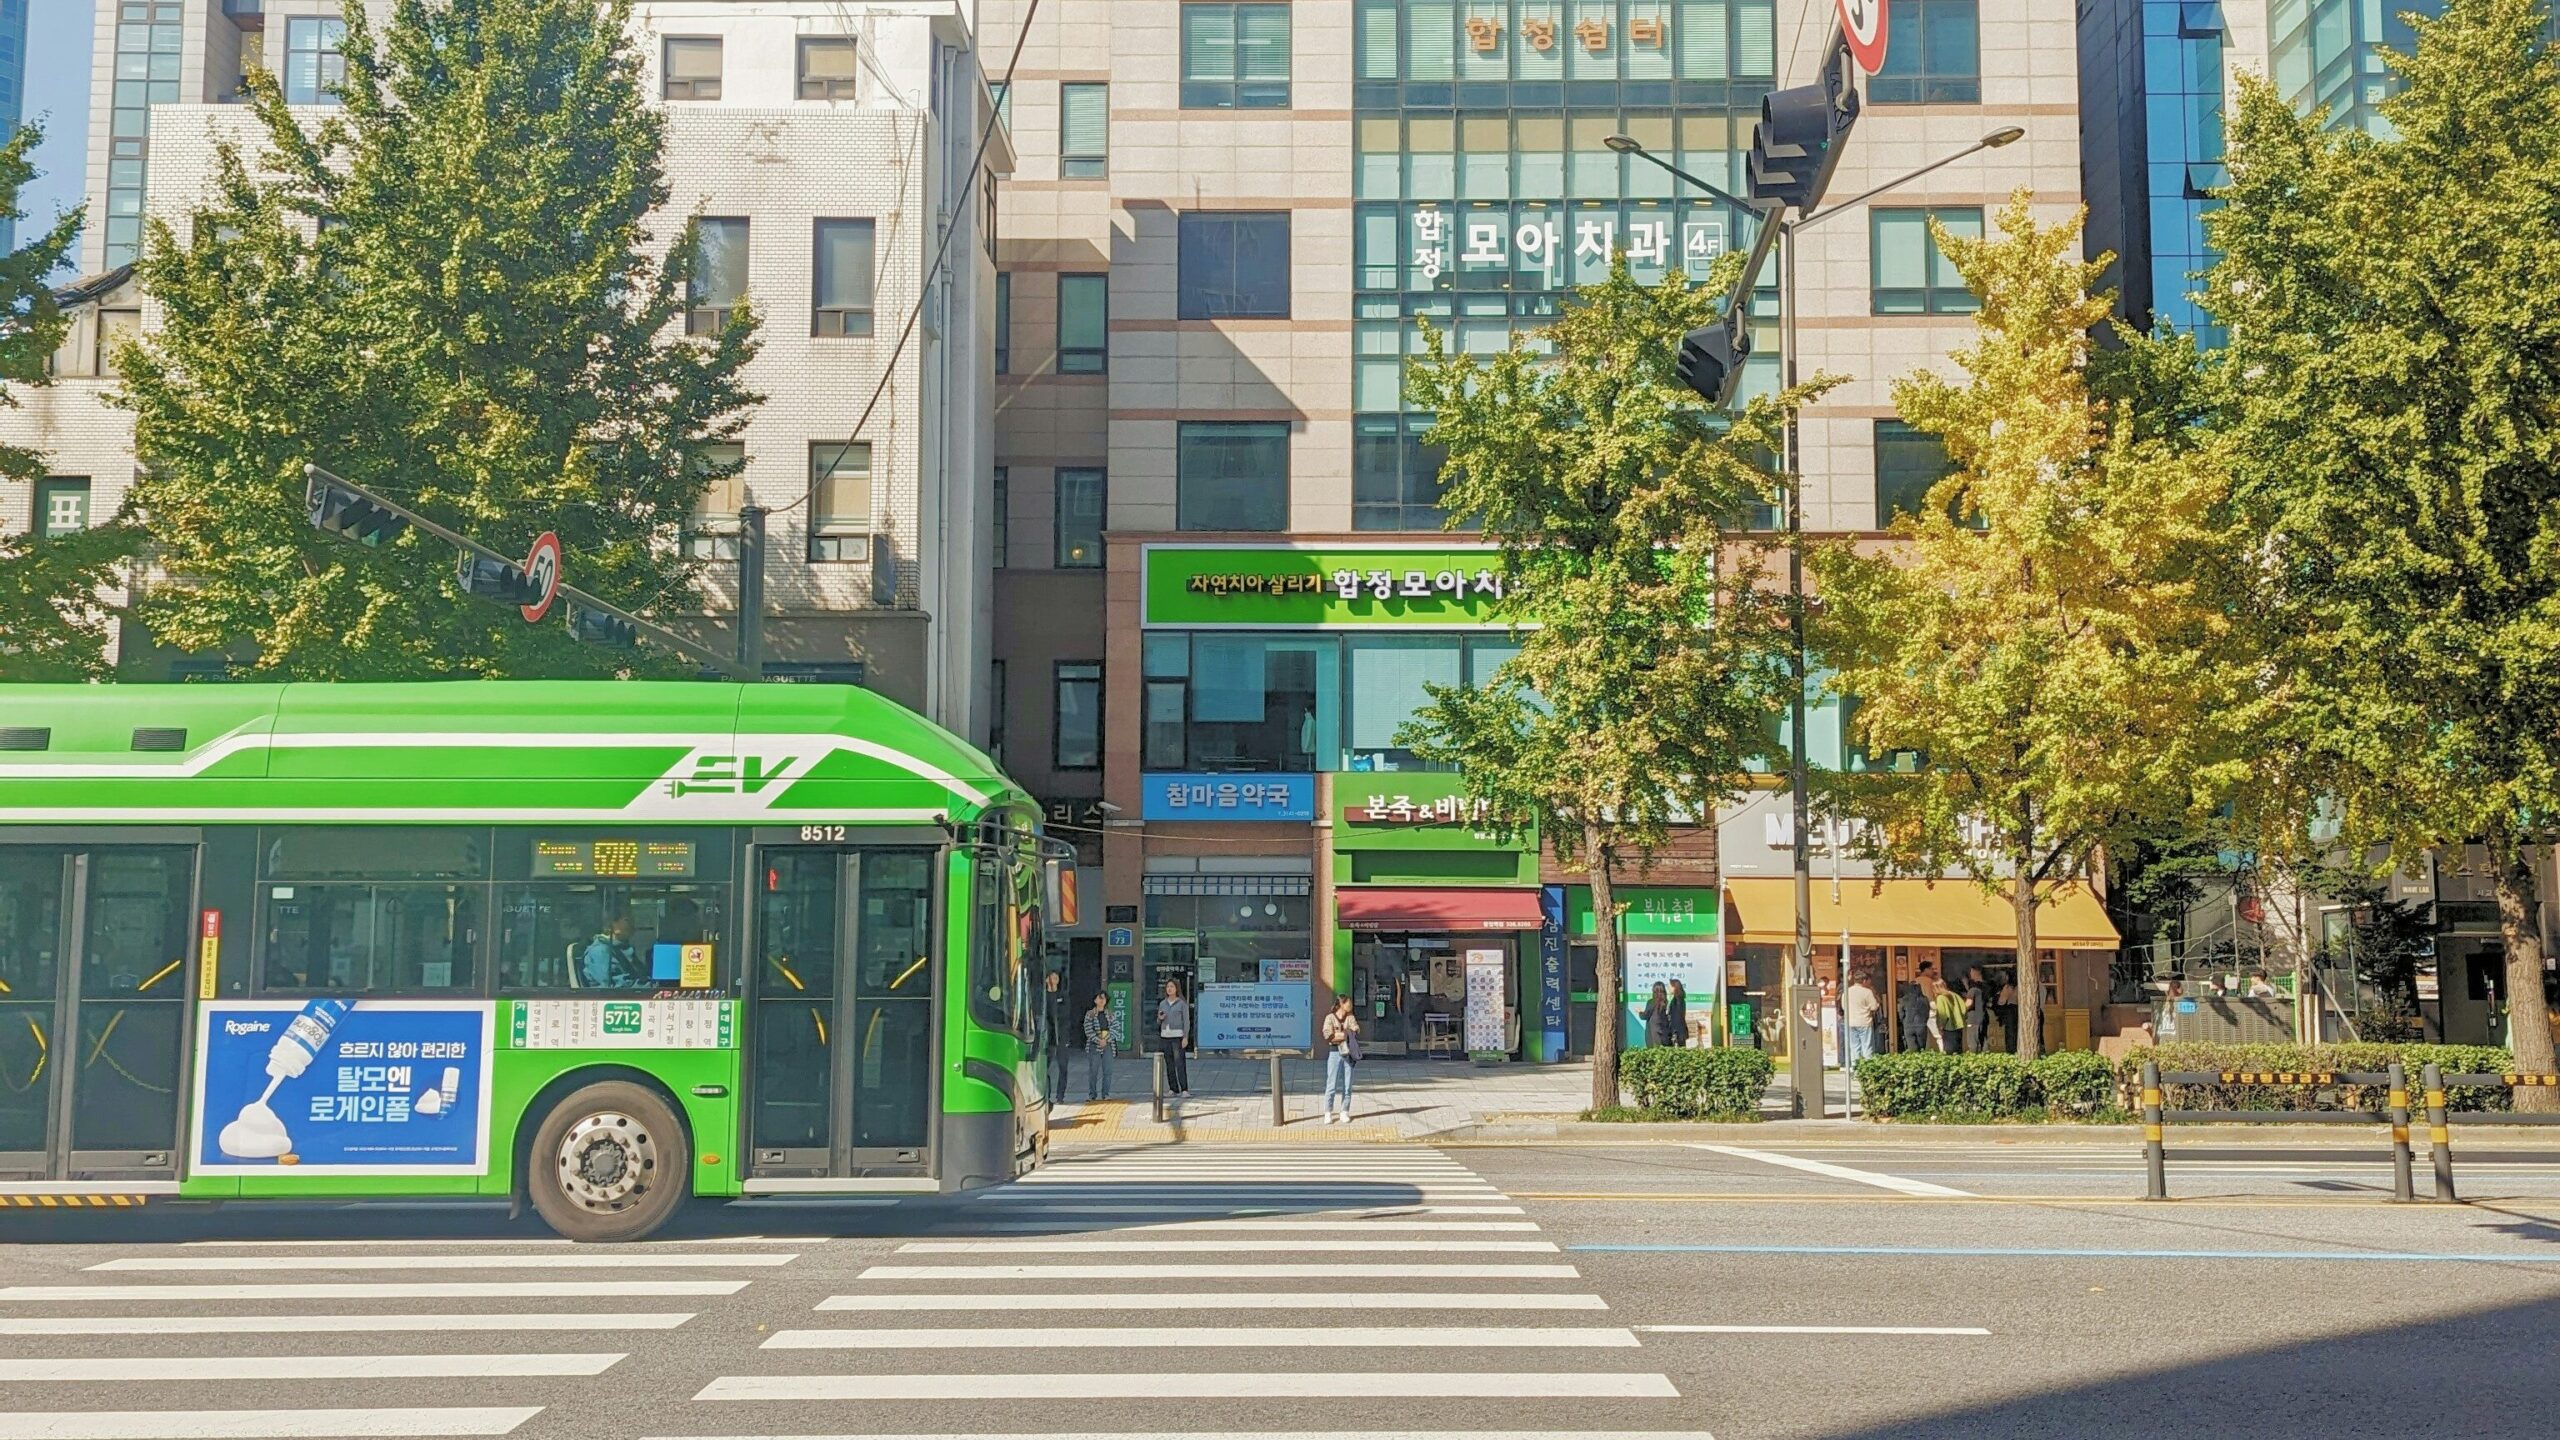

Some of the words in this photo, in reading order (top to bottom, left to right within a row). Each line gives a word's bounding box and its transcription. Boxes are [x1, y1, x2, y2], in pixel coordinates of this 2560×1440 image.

[1466, 16, 1664, 51] 합정쉼터
[1413, 209, 1443, 279] 합정
[1461, 219, 1670, 267] 모아치과
[1688, 229, 1719, 255] 4F
[1191, 574, 1264, 595] 자연치아
[1268, 573, 1322, 595] 살리기
[1332, 568, 1522, 600] 합정모아치
[689, 756, 799, 793] EV
[1166, 783, 1290, 808] 참마음약국
[801, 825, 845, 841] 8512
[594, 842, 638, 876] 5712
[1644, 898, 1694, 924] 복사,출력
[1115, 936, 1126, 945] 73
[1543, 917, 1562, 1026] 삼진출력센타
[225, 1020, 270, 1035] Rogaine
[605, 1011, 640, 1025] 5712
[339, 1042, 384, 1058] 흐르지
[387, 1042, 418, 1058] 않아
[420, 1042, 467, 1059] 편리한
[337, 1066, 412, 1093] 탈모엔
[309, 1095, 411, 1122] 로게인폼
